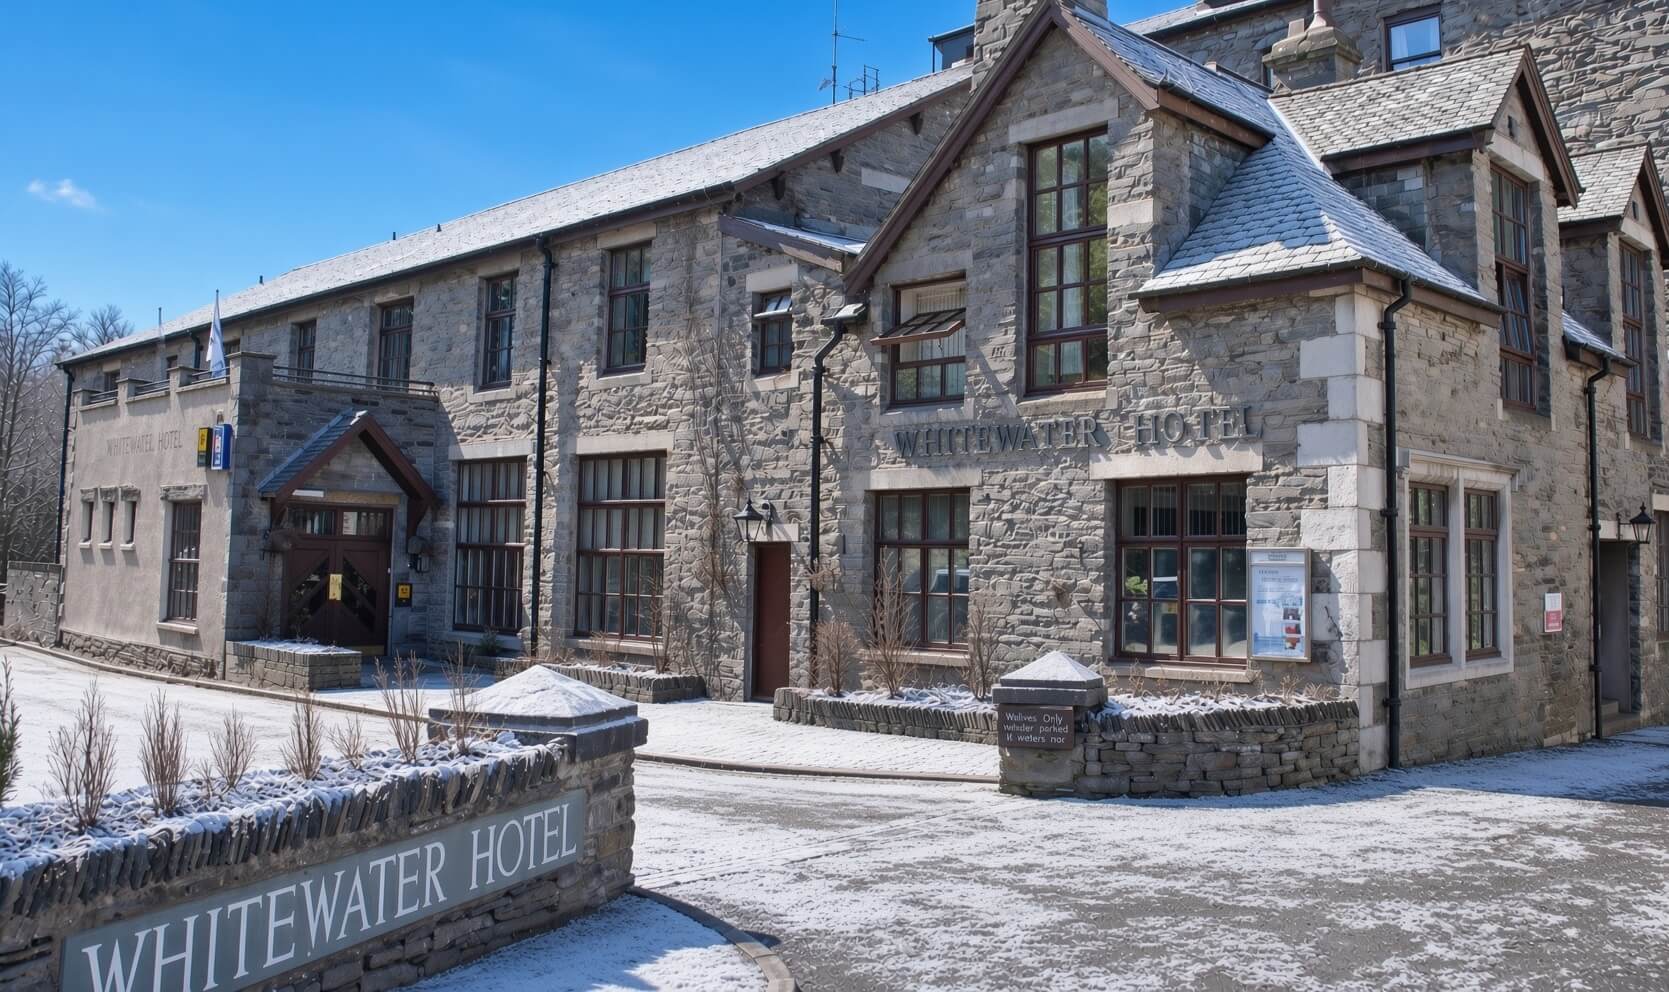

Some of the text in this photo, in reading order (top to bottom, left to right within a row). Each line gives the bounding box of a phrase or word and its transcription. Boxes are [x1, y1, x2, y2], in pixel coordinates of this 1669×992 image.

[158, 430, 183, 451] HOTEL
[893, 405, 1262, 458] WHITEWATER HOTEL
[1043, 713, 1063, 725] Only
[82, 803, 577, 992] WHITEWATER HOTEL
